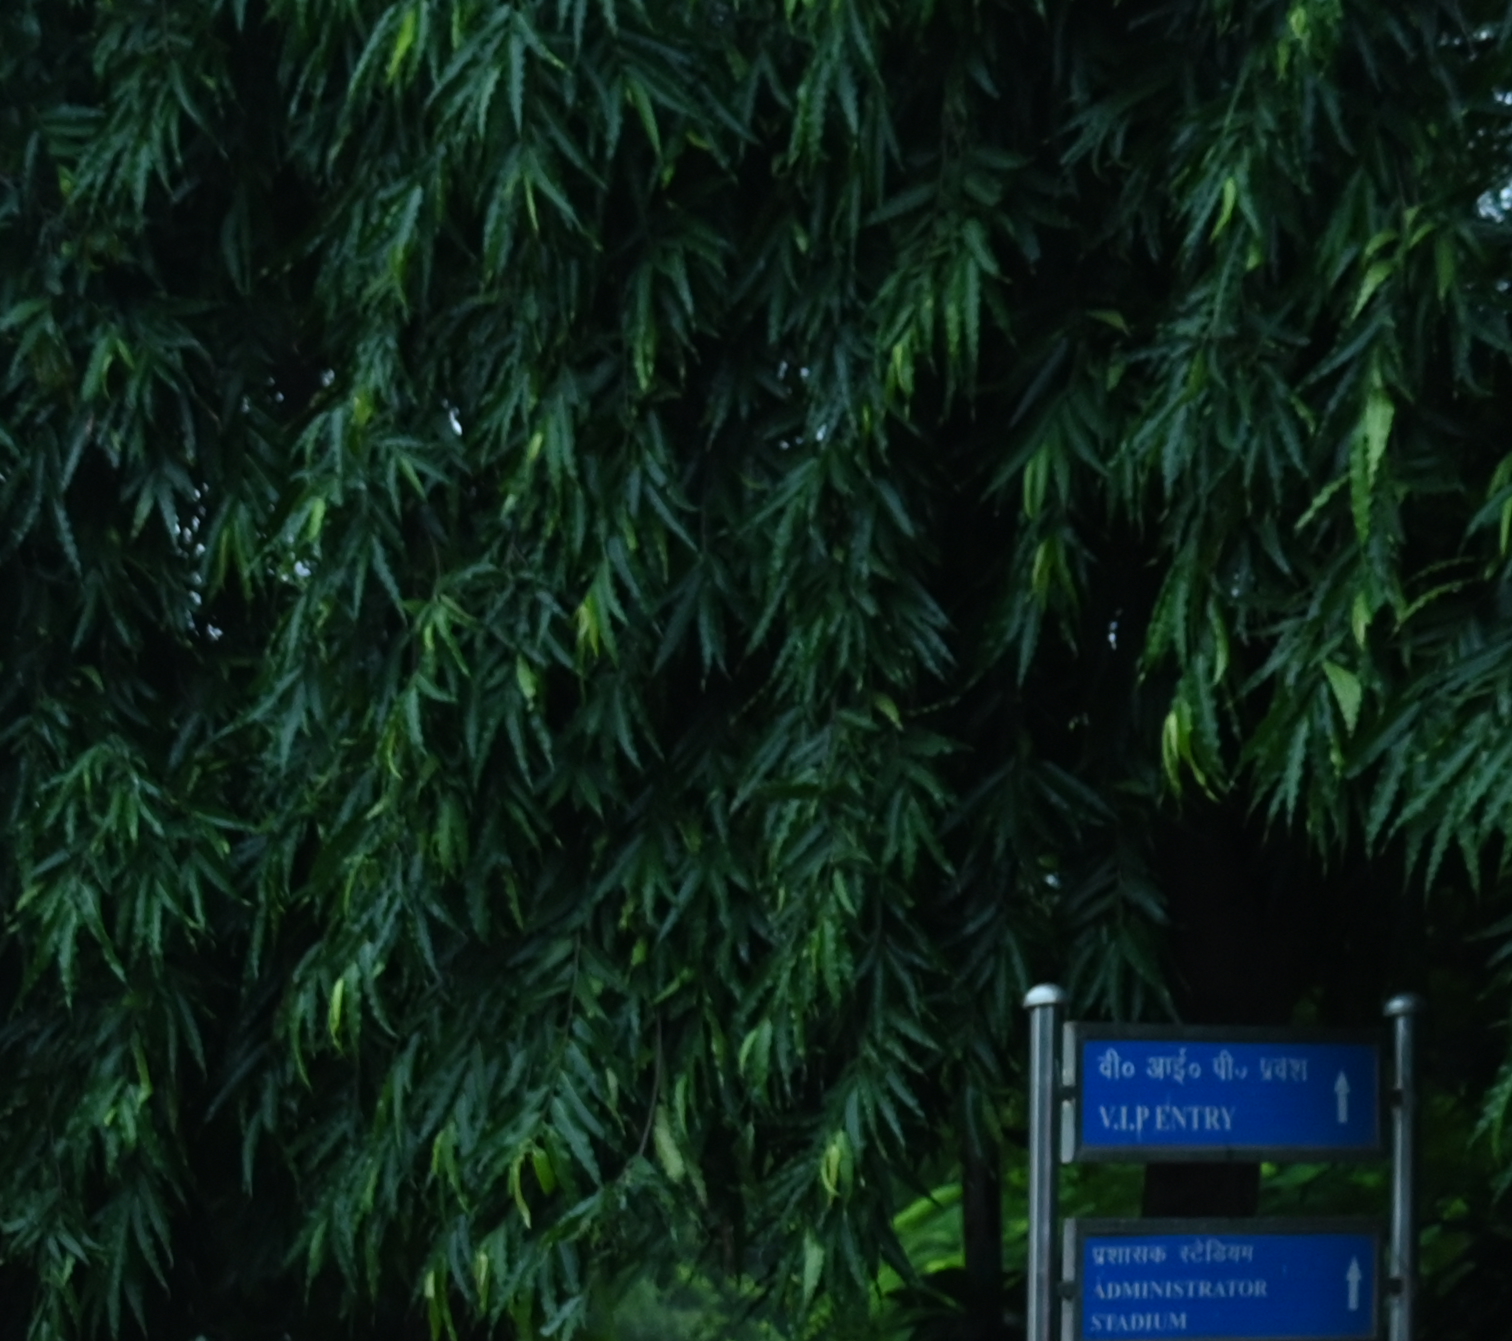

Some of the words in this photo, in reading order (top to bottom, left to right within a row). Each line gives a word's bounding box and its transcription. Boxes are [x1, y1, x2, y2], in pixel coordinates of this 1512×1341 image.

[1155, 1105, 1235, 1131] ENTRY
[1093, 1280, 1268, 1300] ADMINISTRATOR
[1090, 1312, 1188, 1332] STADIUM
